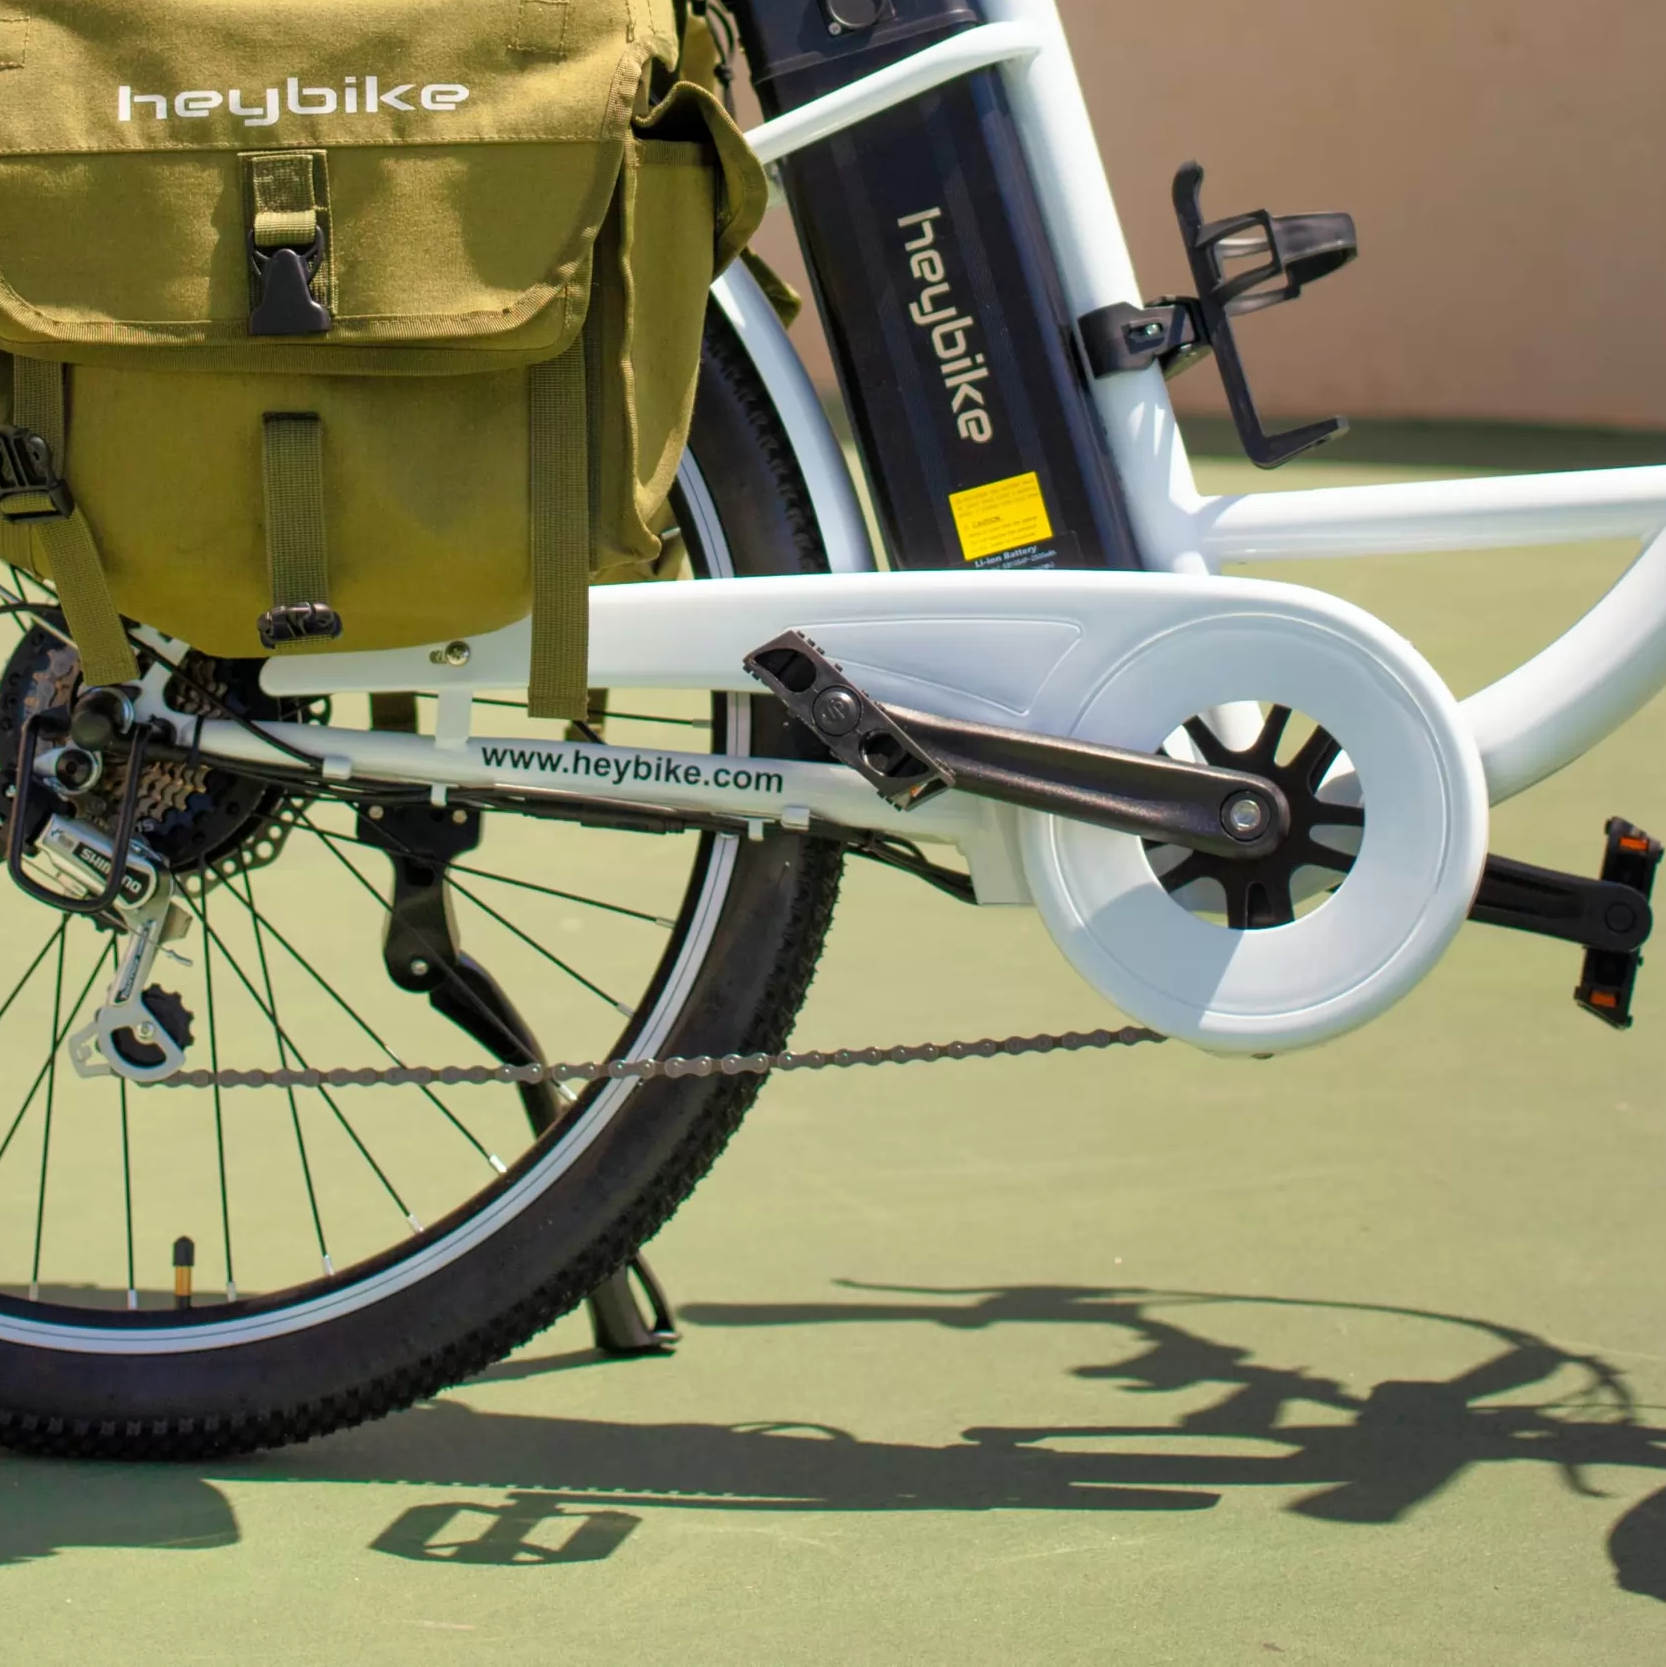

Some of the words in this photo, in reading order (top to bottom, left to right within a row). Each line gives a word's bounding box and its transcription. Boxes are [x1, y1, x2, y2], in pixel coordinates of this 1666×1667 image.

[117, 75, 470, 126] heybike
[897, 207, 992, 443] heybike
[1003, 545, 1037, 560] Battery
[481, 746, 784, 794] www.heybike.com
[80, 848, 142, 893] SHIMNO
